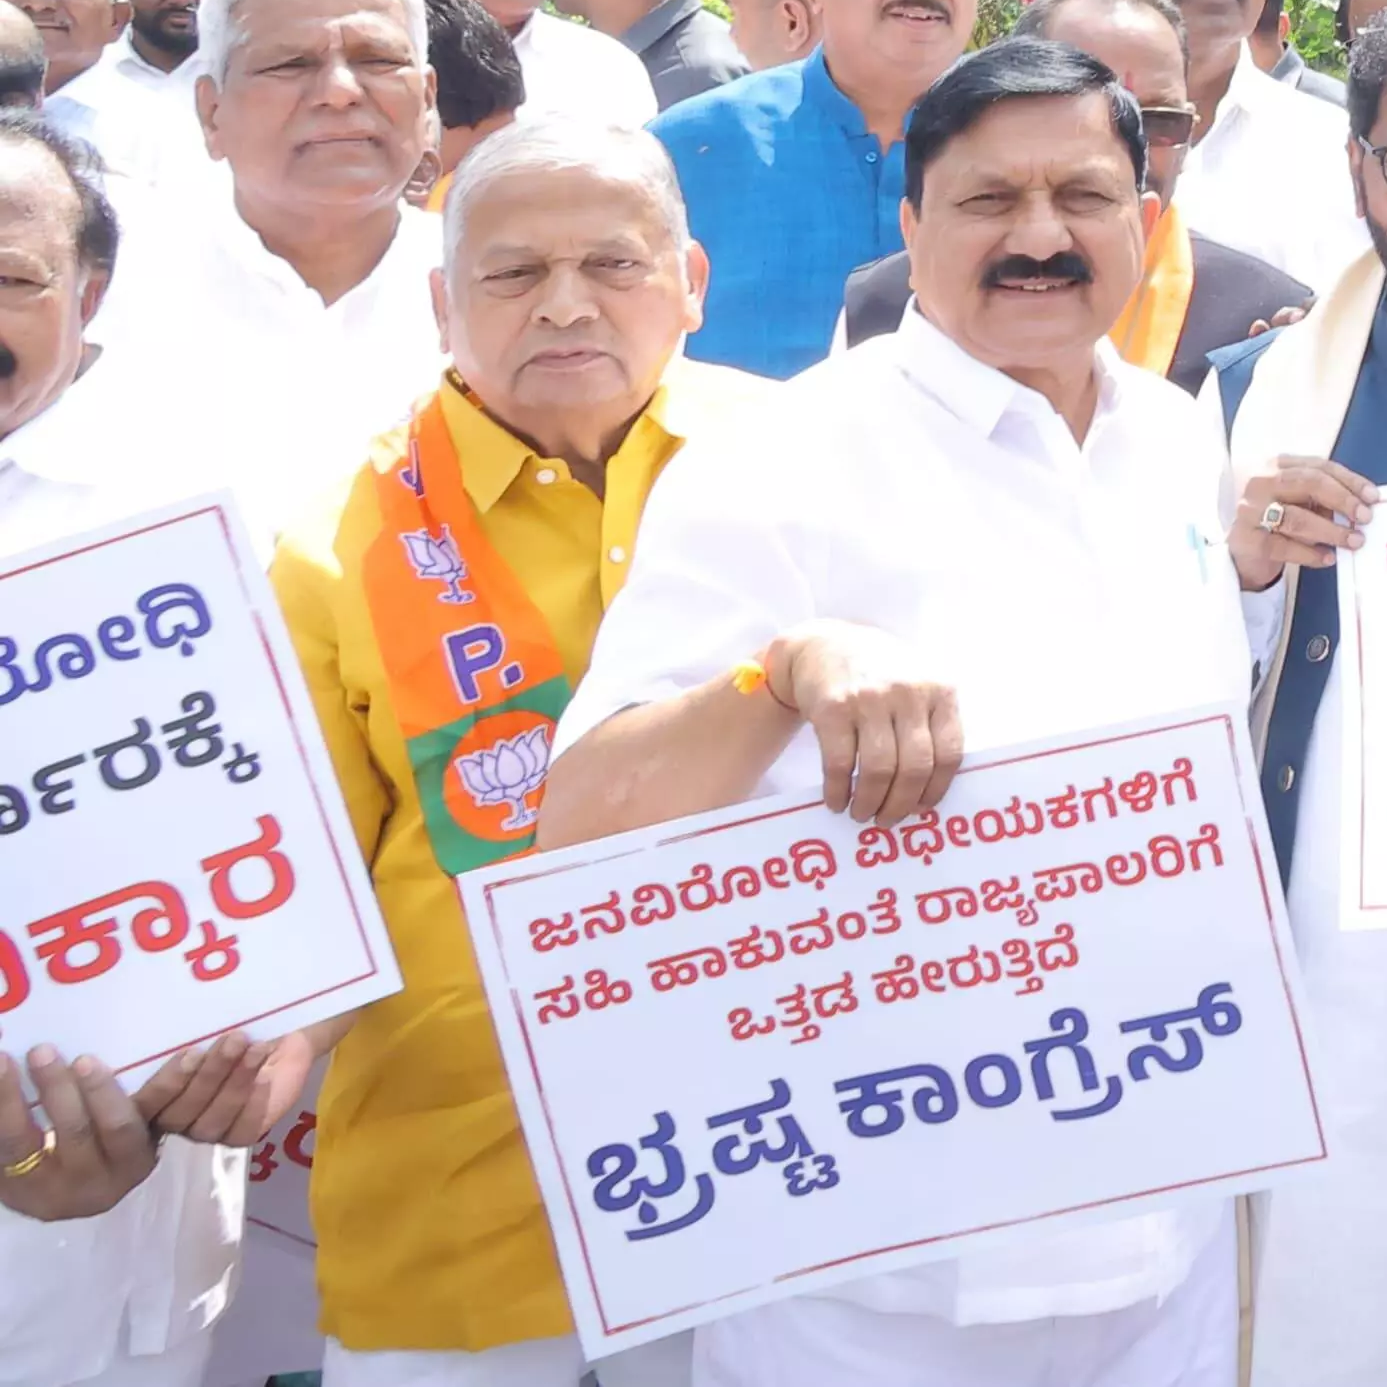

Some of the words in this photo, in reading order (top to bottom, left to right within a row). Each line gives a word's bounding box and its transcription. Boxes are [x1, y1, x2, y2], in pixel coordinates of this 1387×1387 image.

[443, 625, 520, 702] P.
[529, 839, 837, 952] ಜನವಿರೋಧಿ
[856, 758, 1197, 868] ವಿಧೇಯಕಗಳಿಗೆ
[534, 969, 632, 1024] ಸಹಿ
[646, 888, 901, 992] ಹಾಕುವಂತೆ
[915, 824, 1223, 926] ರಾಜ್ಯಪಾಲರಿಗೆ
[728, 971, 858, 1044] ಒತ್ತಡ
[872, 919, 1078, 1003] ಹೇರುತ್ತಿದೆ
[586, 1078, 840, 1242] ಭ್ರಷ್ಟ
[835, 982, 1242, 1138] ಕಾಂಗ್ರೆಸ್
